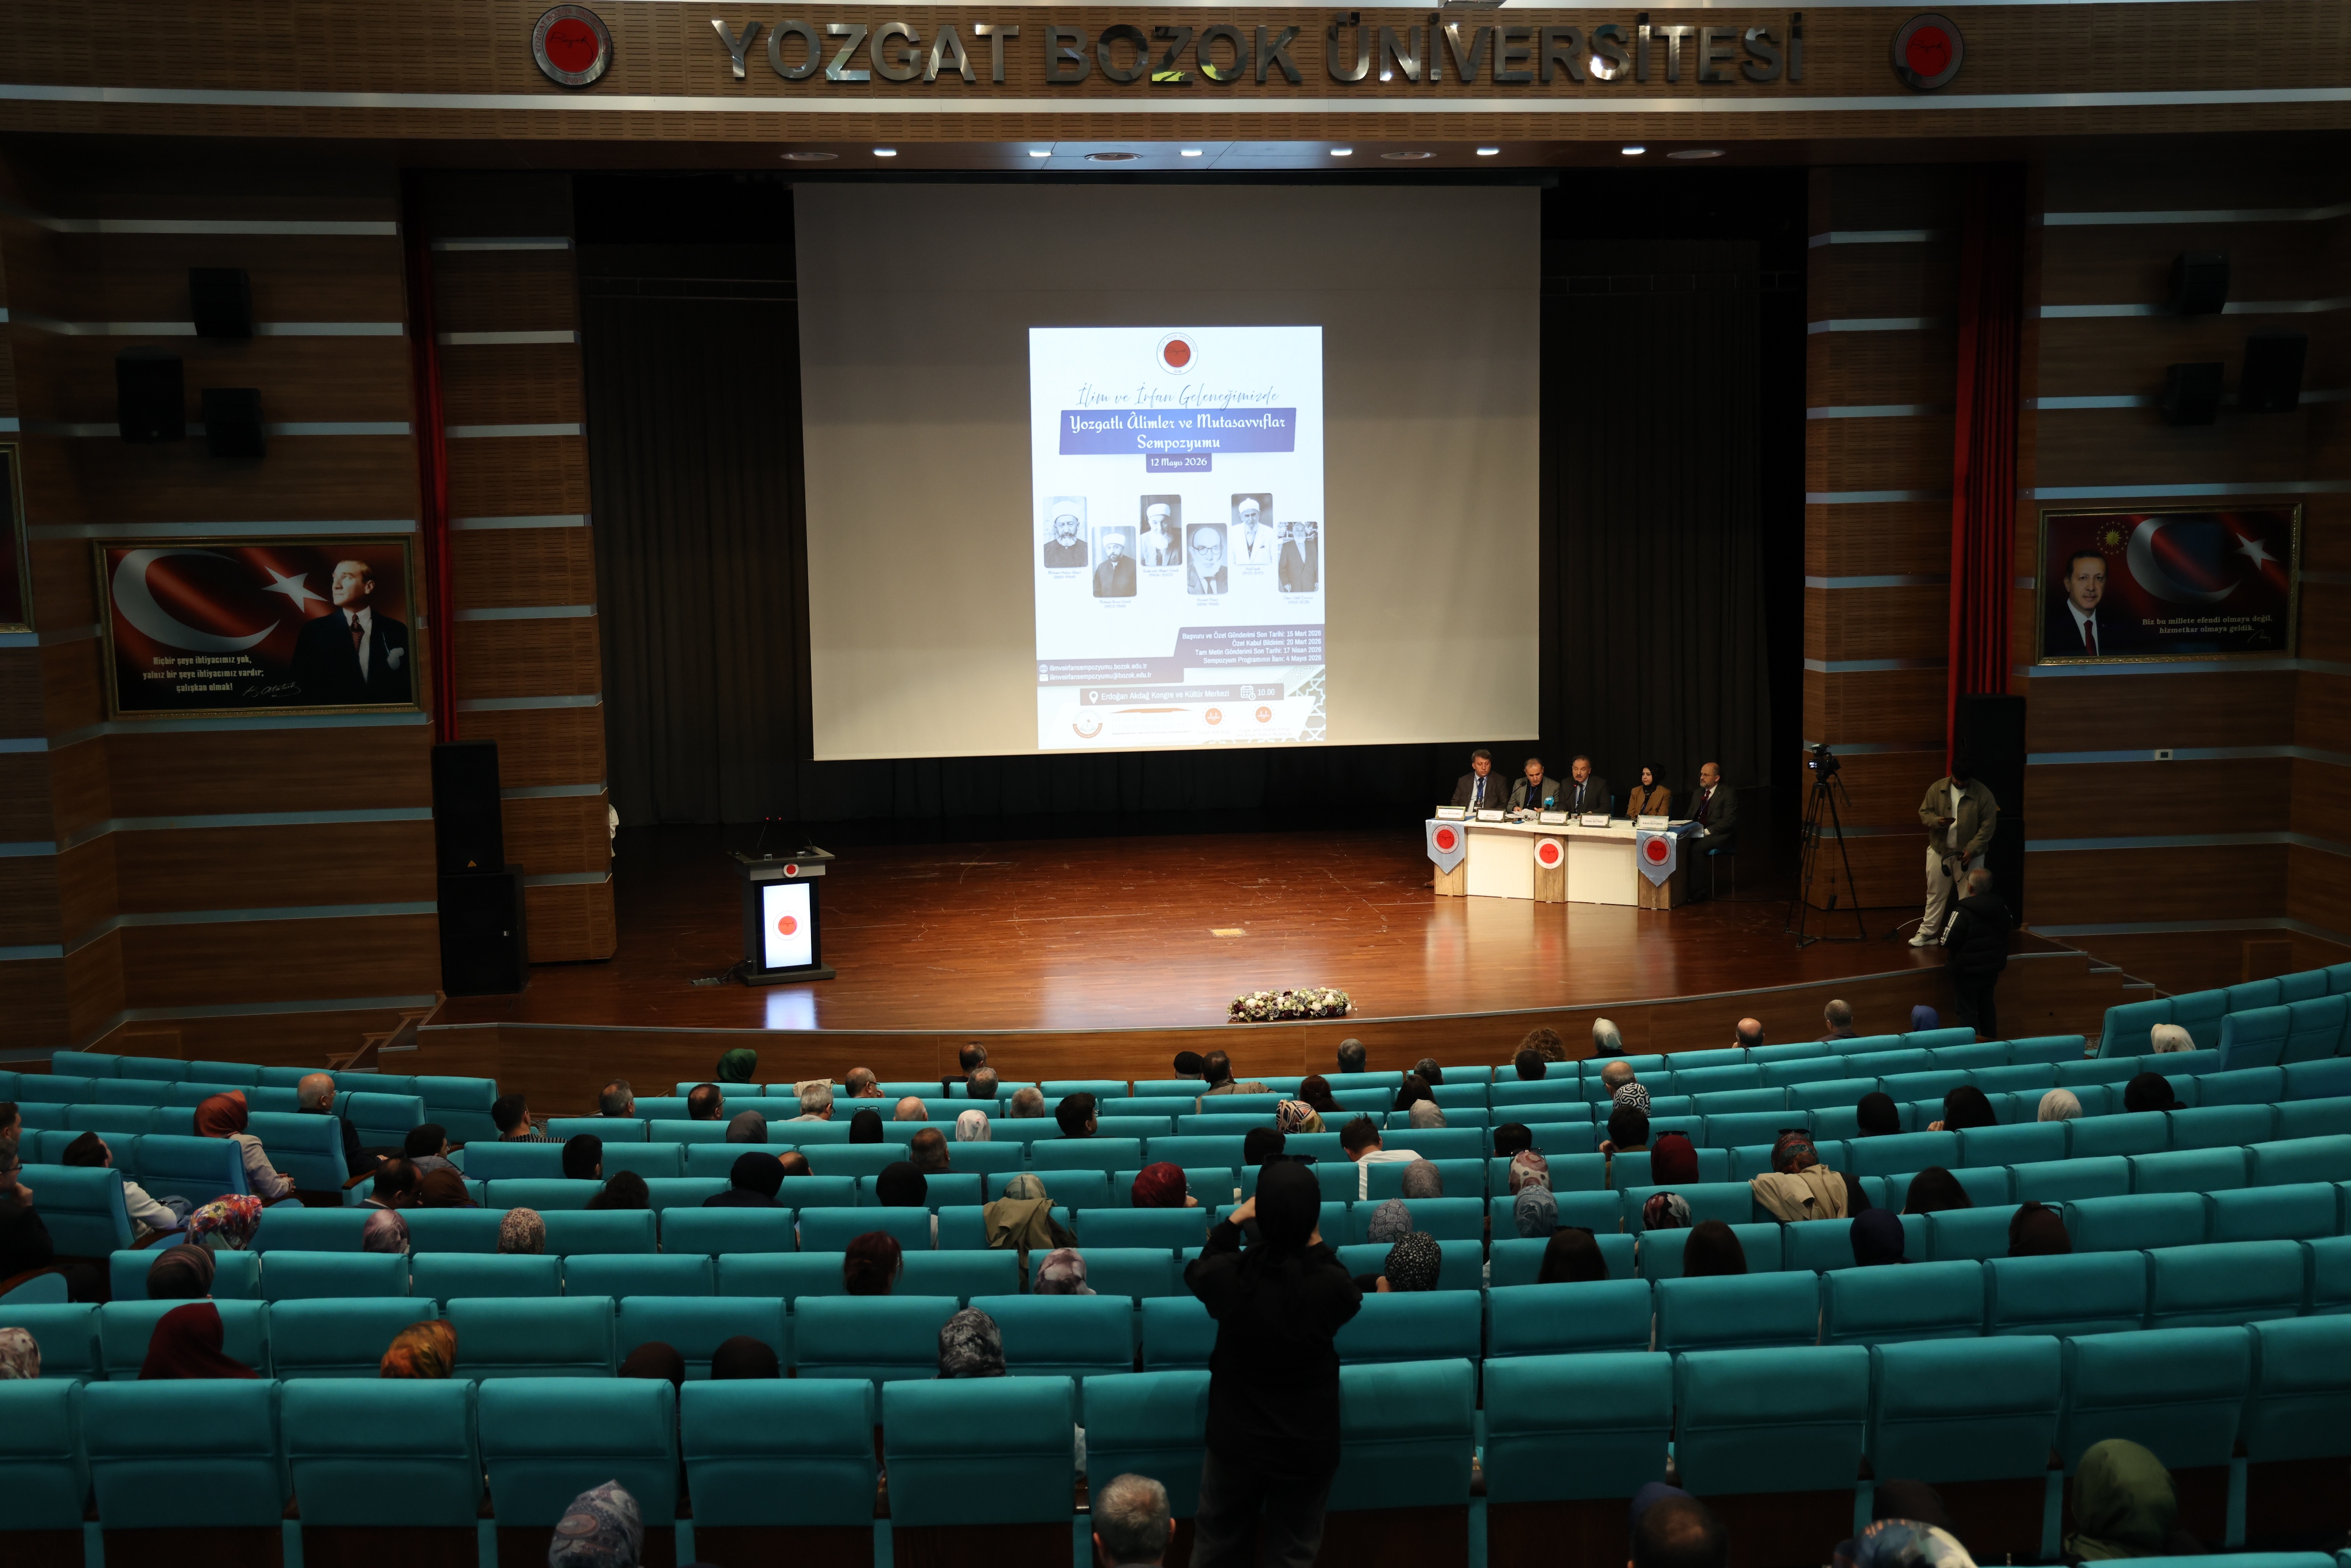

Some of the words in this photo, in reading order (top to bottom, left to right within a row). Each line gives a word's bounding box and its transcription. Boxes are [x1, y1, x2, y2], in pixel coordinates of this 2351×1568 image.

[535, 20, 547, 53] YOZGAT
[546, 8, 572, 22] BOZOK
[711, 20, 1019, 82] YOZGAT
[1046, 23, 1302, 82] BOZOK
[1326, 11, 1802, 81] ÜNİVERSİTESİ
[1076, 383, 1111, 408] İlim
[1115, 394, 1131, 403] ve
[1134, 382, 1175, 409] İrfan
[1179, 383, 1280, 412] Geleneğimizde
[1069, 415, 1124, 433] Yozgatlı
[1127, 411, 1176, 429] Âlimler
[1178, 419, 1193, 429] ve
[1197, 413, 1286, 430] Mutasavvıflar
[1136, 434, 1221, 452] Sempozyumu
[1150, 458, 1159, 466] 12
[1161, 457, 1183, 468] Mayıs
[1184, 457, 1208, 466] 2026
[2222, 615, 2250, 623] olmaya
[2229, 624, 2255, 633] geldik.
[1182, 632, 1205, 641] Başvuru
[1213, 631, 1227, 639] Özet
[153, 657, 176, 666] Hiçbir
[177, 656, 194, 666] şeye
[195, 655, 235, 665] ihtiyacımız
[236, 655, 252, 664] yok,
[1271, 654, 1285, 662] İlanı:
[1049, 663, 1147, 672] ilimveirfansempozyumu.bozok.edu.tr
[143, 670, 165, 680] yalnız
[166, 670, 177, 678] bir
[179, 670, 196, 680] şeye
[197, 669, 237, 678] ihtiyacımız
[238, 668, 264, 677] vardır;
[1049, 672, 1152, 681] ilimveirfansempozyumu@bozok.edu.tr
[176, 683, 207, 693] çalışkan
[208, 682, 233, 692] olmak!
[1257, 688, 1275, 696] 10.00
[1101, 692, 1128, 701] Erdoğan
[1129, 691, 1150, 701] Akdağ
[1151, 691, 1174, 700] Kongre
[1185, 690, 1204, 698] Kültür
[1204, 689, 1229, 697] Merkezi
